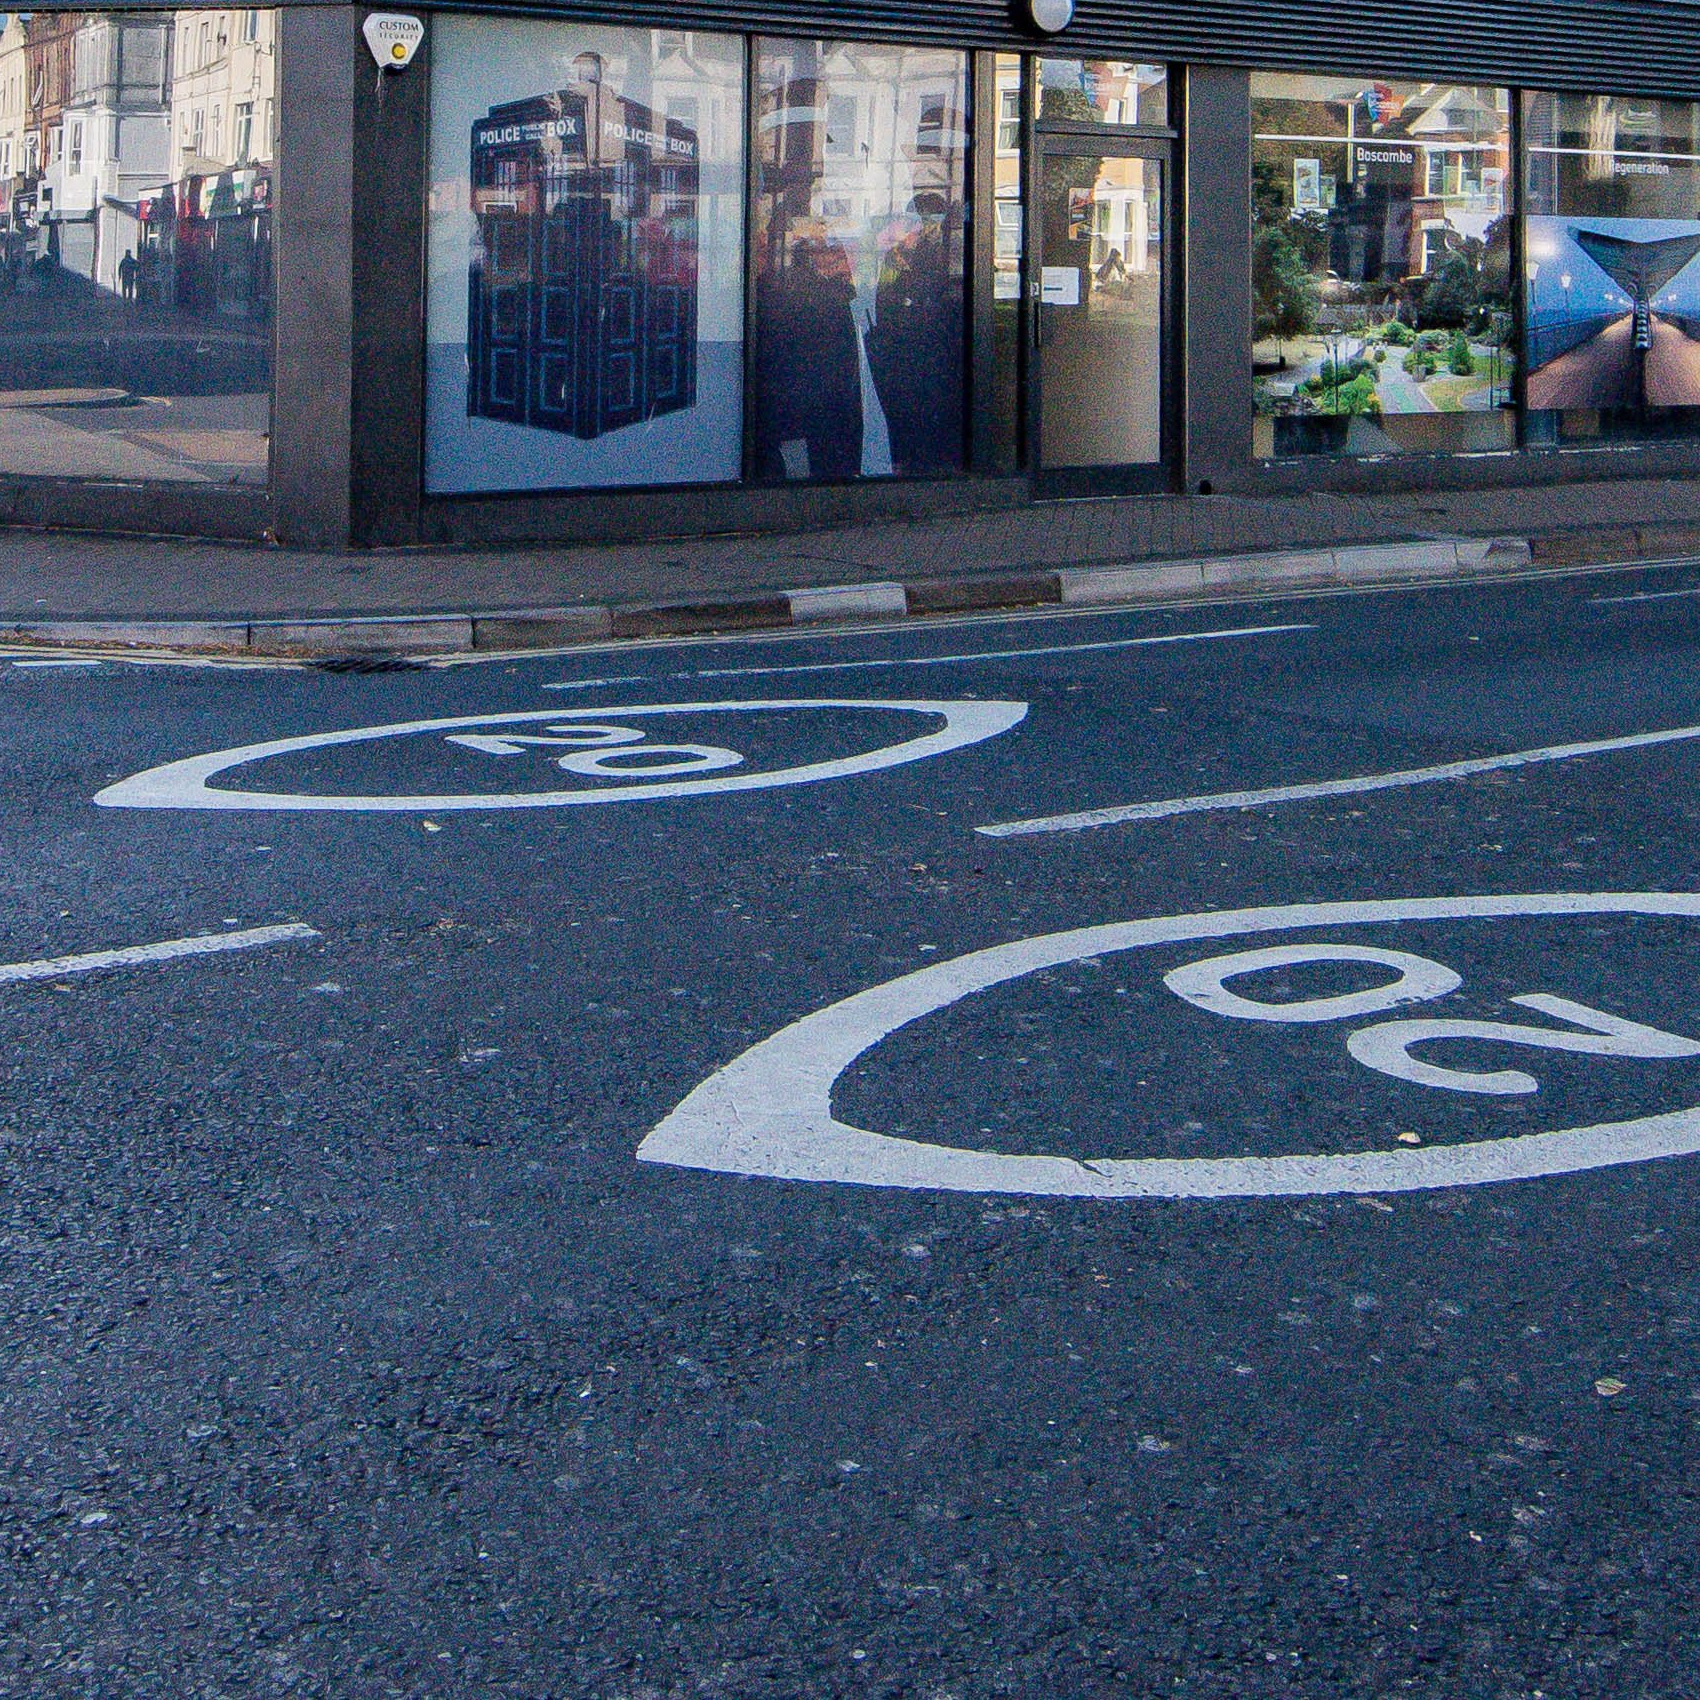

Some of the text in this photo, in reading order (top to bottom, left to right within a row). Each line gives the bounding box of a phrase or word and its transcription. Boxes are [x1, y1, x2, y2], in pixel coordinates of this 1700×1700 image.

[379, 20, 419, 32] CUSTOM
[479, 118, 577, 146] POLICE BOX
[604, 121, 652, 145] POLICE
[670, 138, 694, 157] BOX
[1356, 147, 1413, 163] Boscombe
